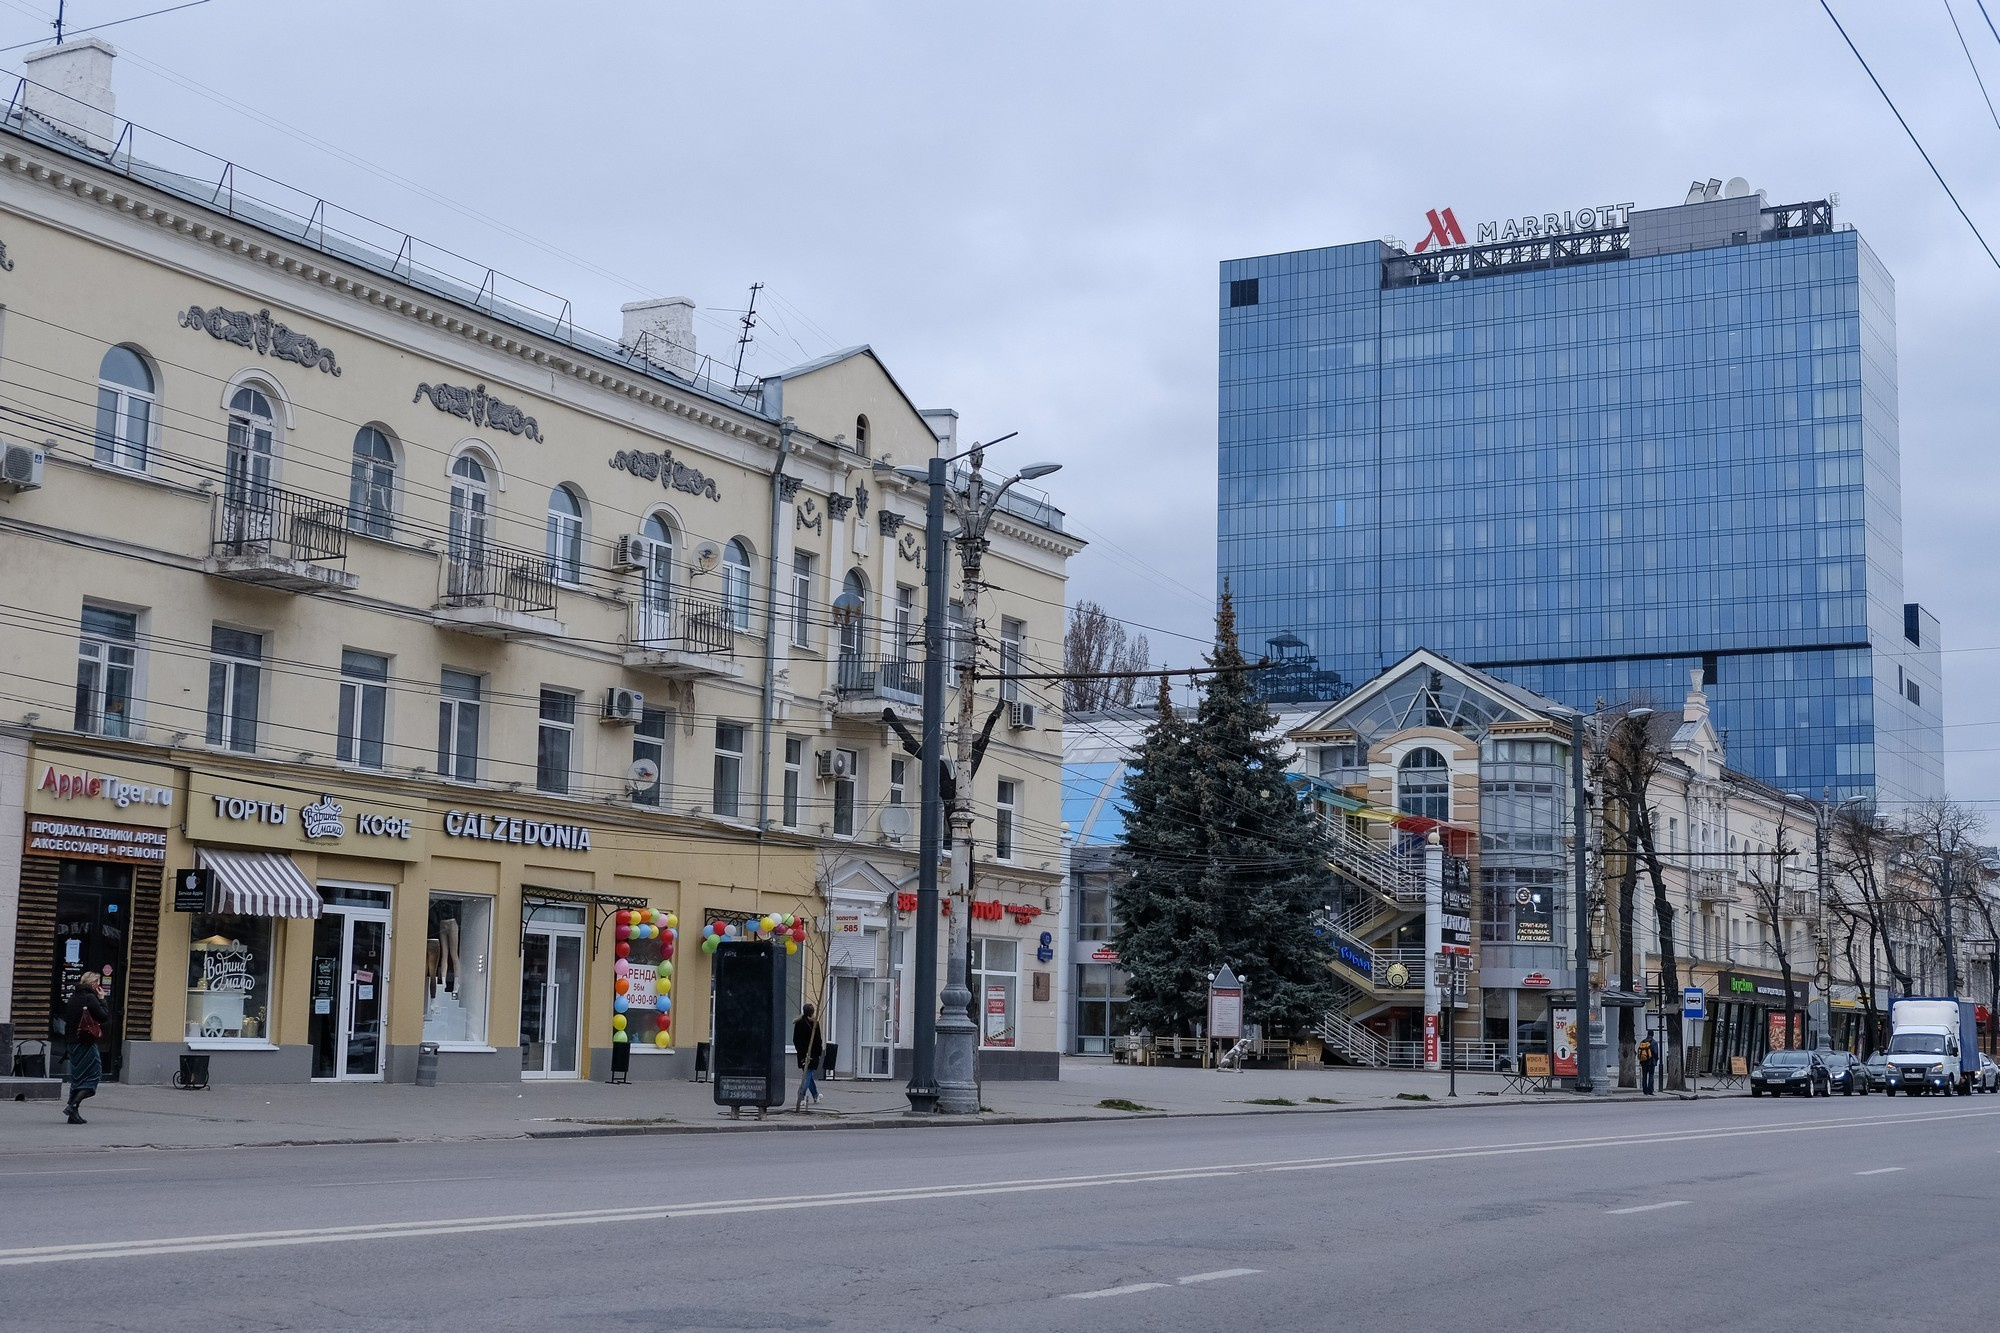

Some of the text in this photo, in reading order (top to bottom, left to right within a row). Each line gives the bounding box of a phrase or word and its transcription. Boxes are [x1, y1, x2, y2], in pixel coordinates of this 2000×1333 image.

[1477, 202, 1635, 243] MARRIOTT
[37, 766, 173, 808] AppleTiger.ru
[213, 795, 288, 825] ТОРТЫ
[31, 821, 87, 838] ПРОДАЖА
[86, 826, 133, 842] ТЕХНИКИ
[357, 812, 413, 839] КОФЕ
[445, 809, 592, 851] CALZEDONIA
[30, 837, 166, 860] АКСЕССУАРЫ РЕМОНТ
[897, 891, 918, 911] 585
[843, 924, 858, 933] 585
